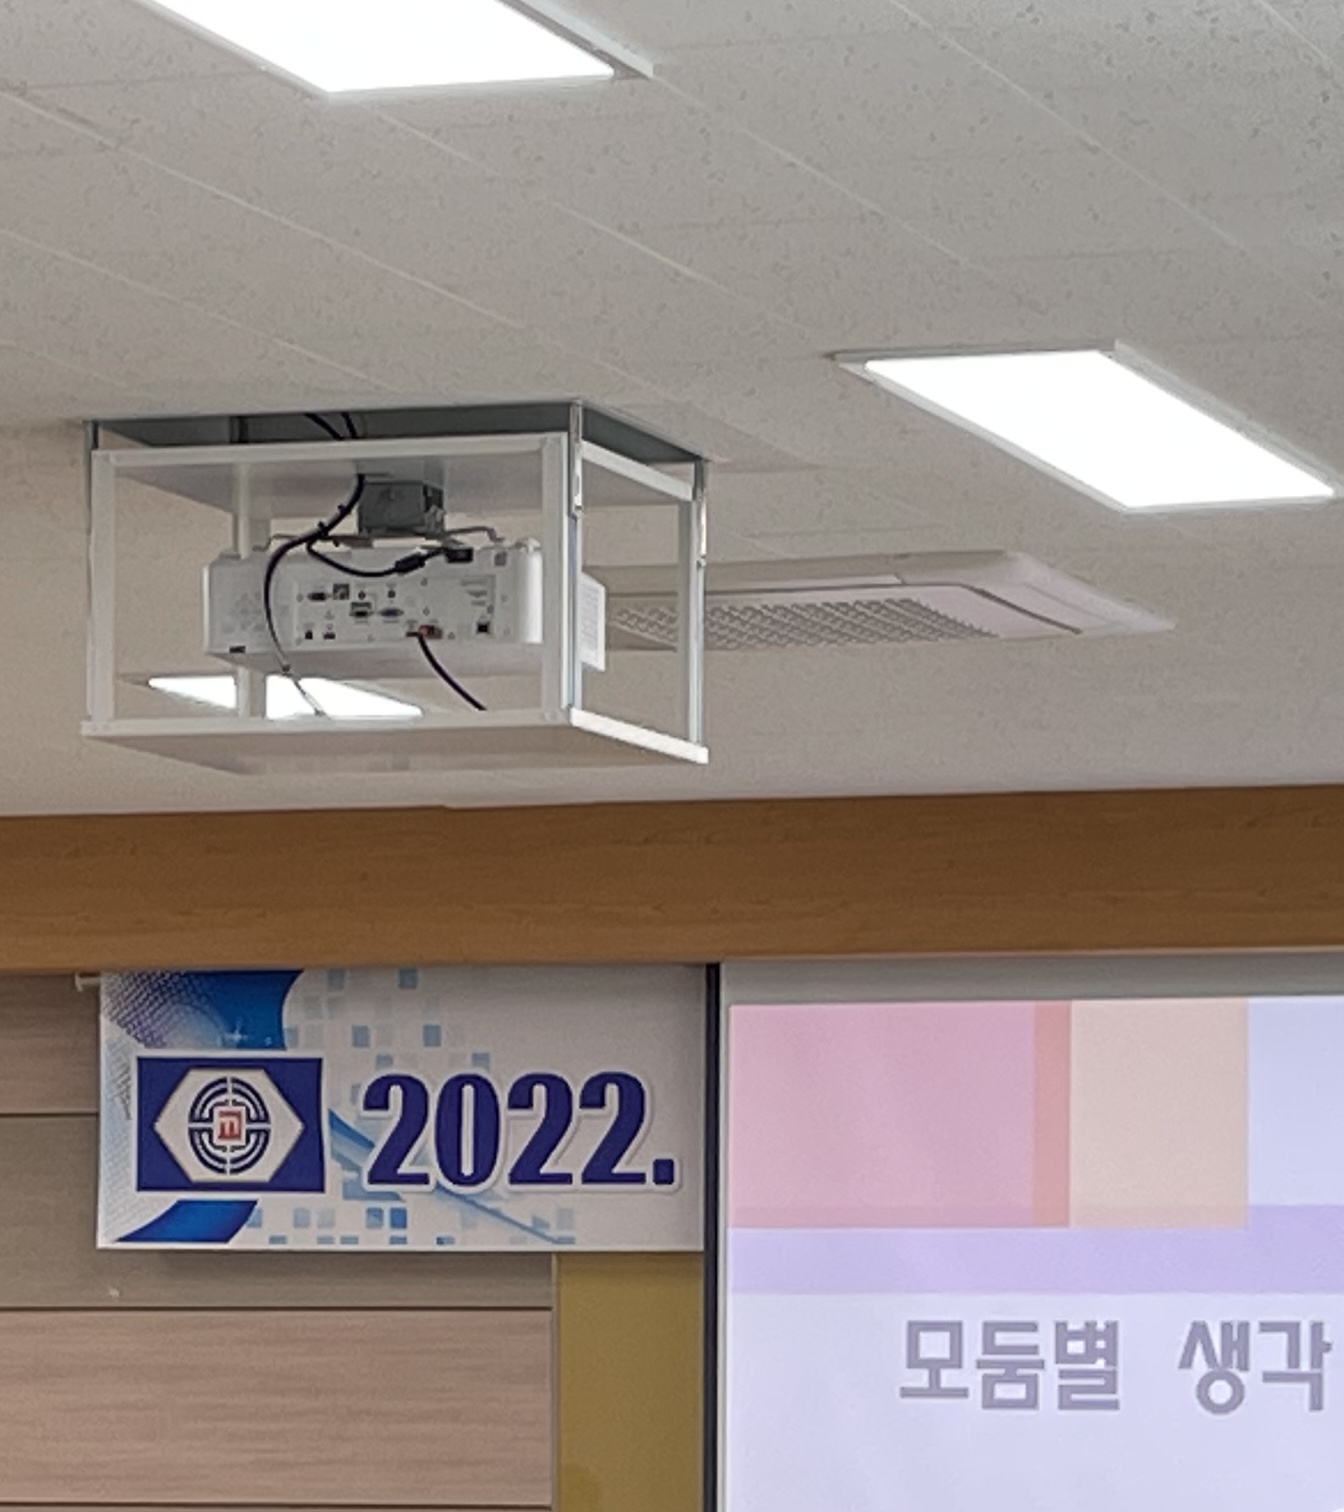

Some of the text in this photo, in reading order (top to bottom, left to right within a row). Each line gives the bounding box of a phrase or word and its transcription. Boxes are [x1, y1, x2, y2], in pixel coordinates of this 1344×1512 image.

[361, 1072, 675, 1186] 2022.
[899, 1319, 1121, 1413] 모둠별
[1178, 1319, 1333, 1415] 생각
